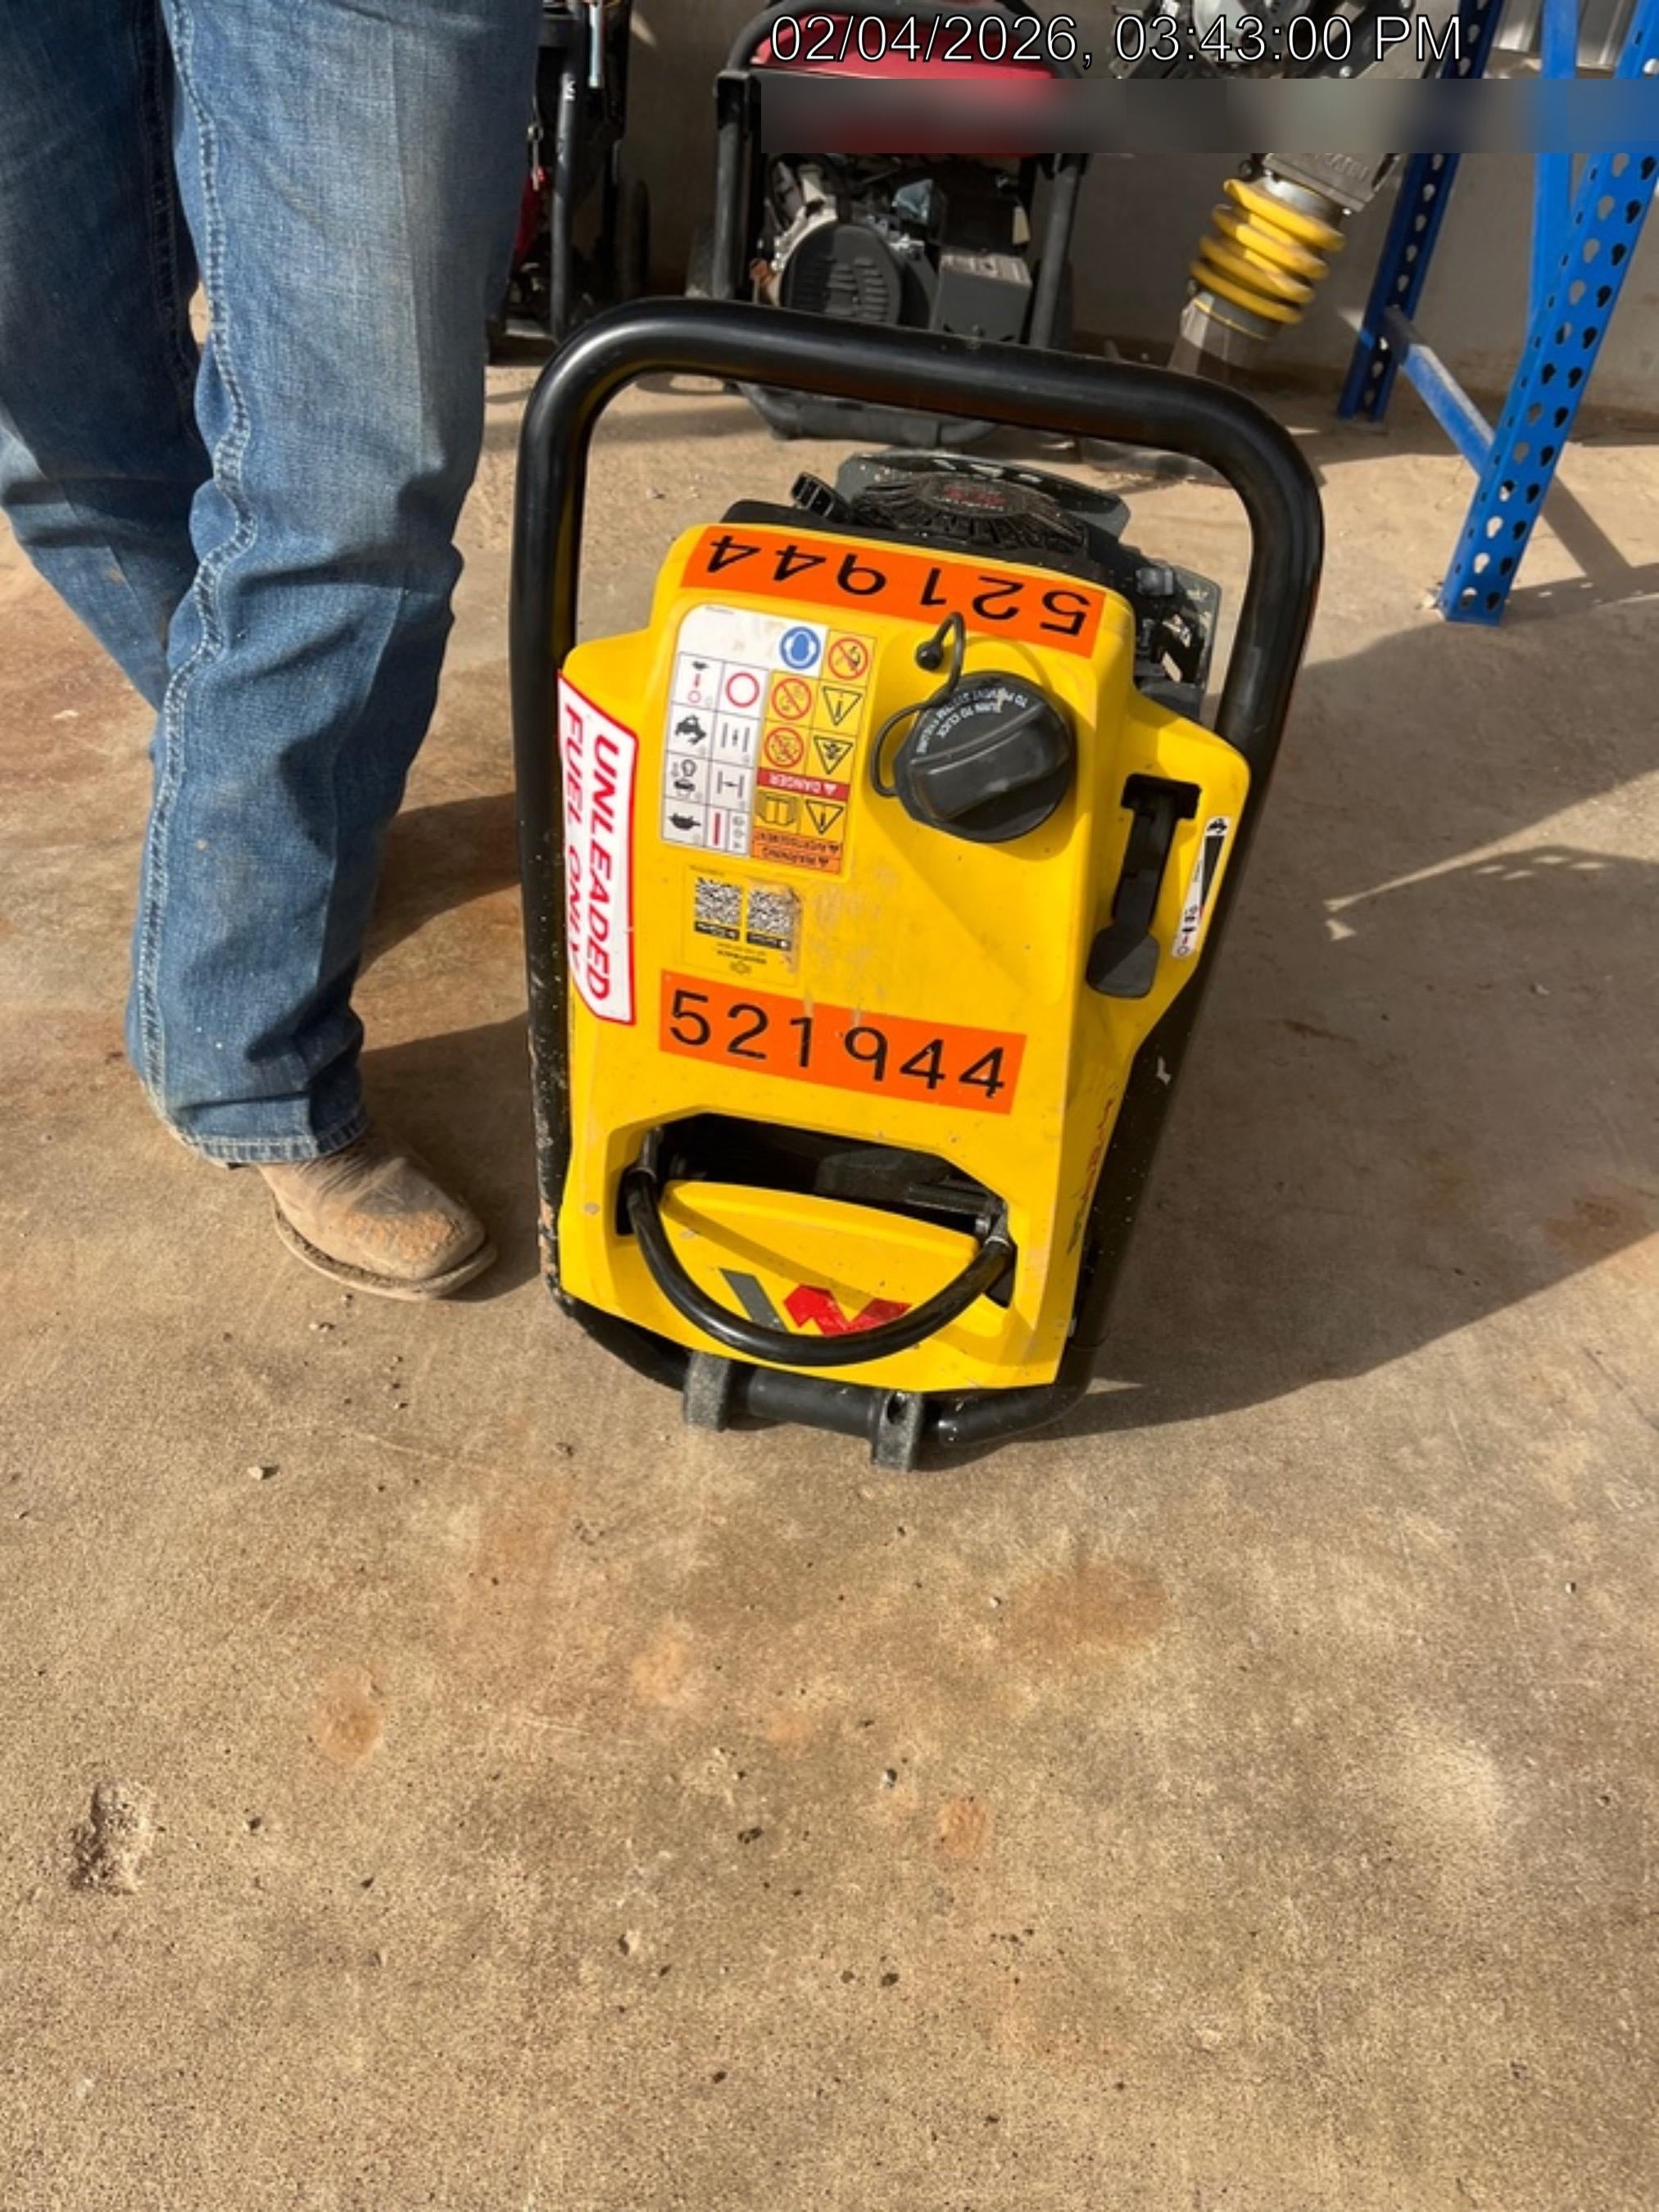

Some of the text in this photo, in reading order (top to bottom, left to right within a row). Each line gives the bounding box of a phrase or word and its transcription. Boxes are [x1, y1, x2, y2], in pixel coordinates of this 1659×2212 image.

[707, 534, 1090, 636] 521944
[565, 702, 583, 824] FUEL
[586, 733, 619, 1001] UNLEADED
[669, 989, 1005, 1099] 521944
